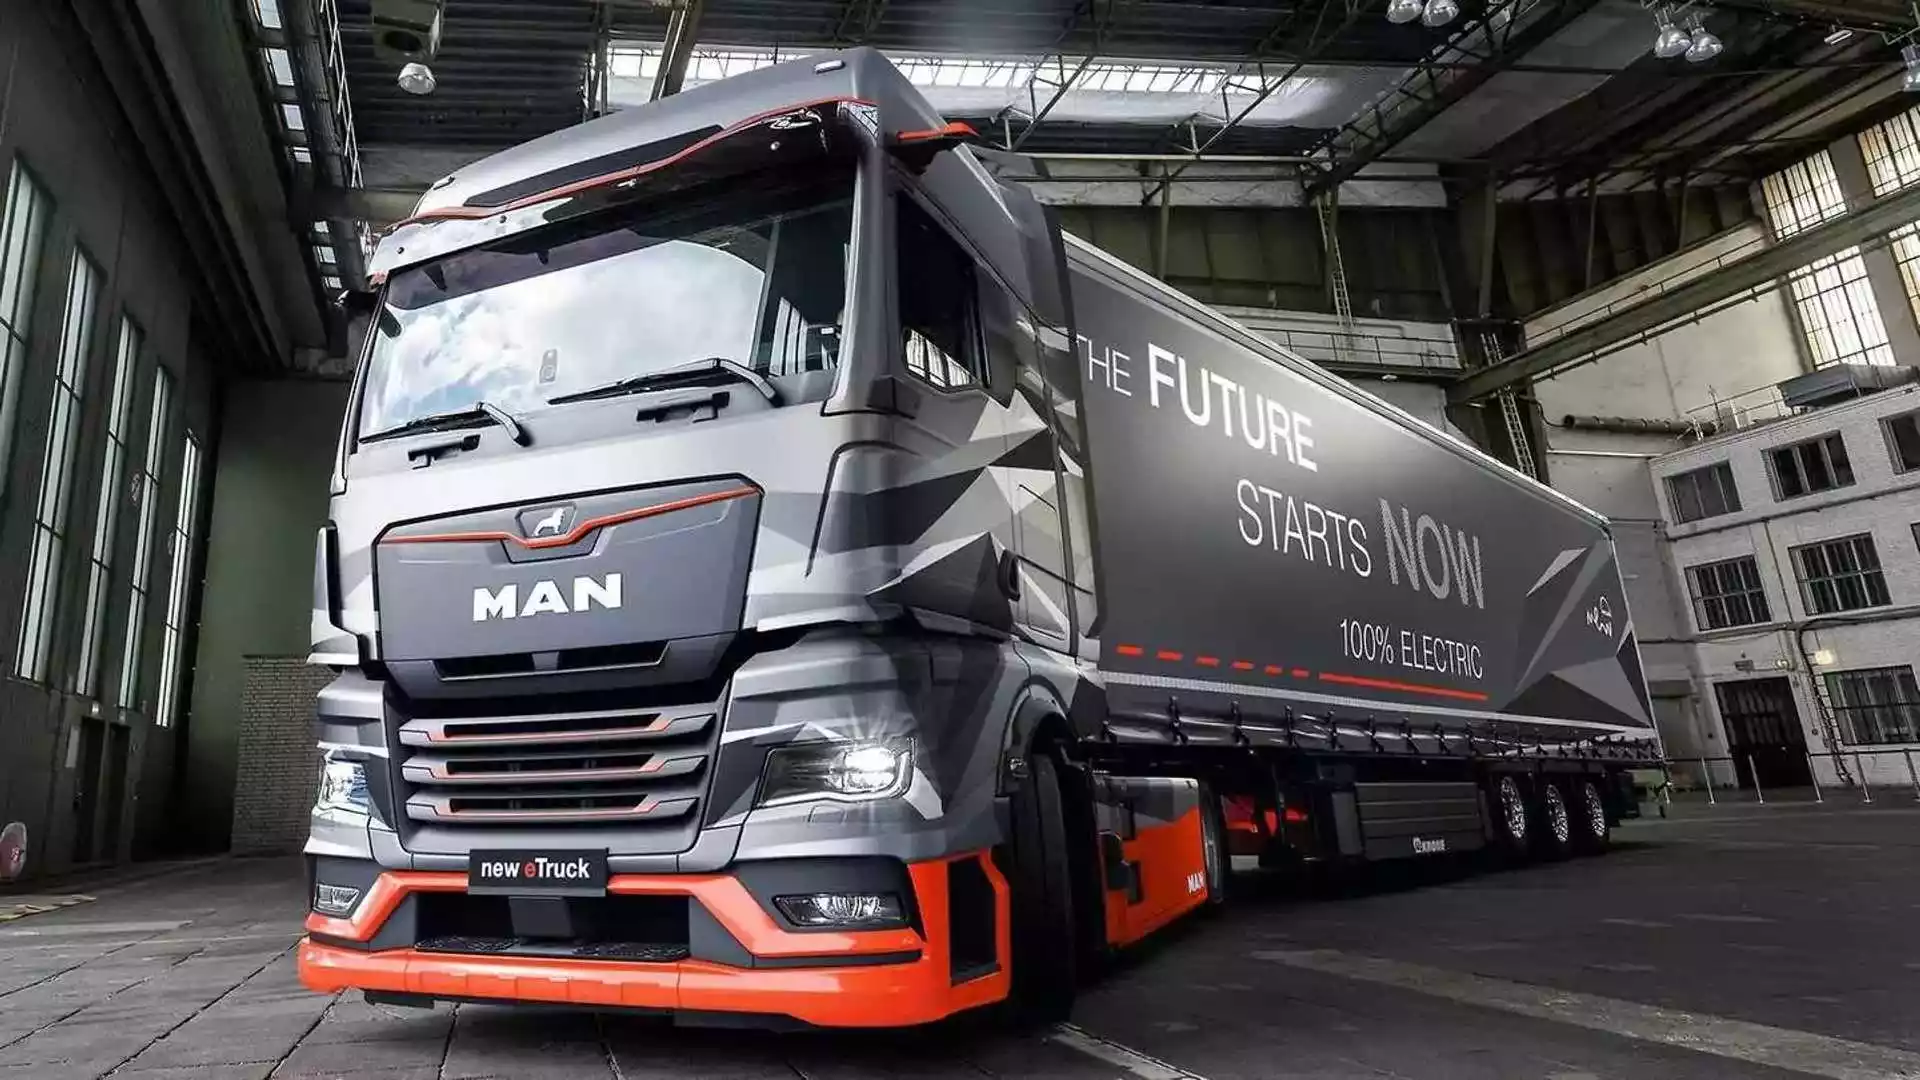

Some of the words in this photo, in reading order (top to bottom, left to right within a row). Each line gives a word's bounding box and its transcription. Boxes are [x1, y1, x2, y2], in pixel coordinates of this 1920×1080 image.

[1147, 343, 1318, 472] FUTURE
[1236, 478, 1371, 578] STARTS
[1379, 498, 1484, 609] NOW
[472, 572, 622, 622] MAN
[1340, 618, 1394, 665] 100%
[1401, 630, 1483, 680] ELECTRIC
[481, 861, 520, 878] new
[524, 857, 590, 878] eTruck
